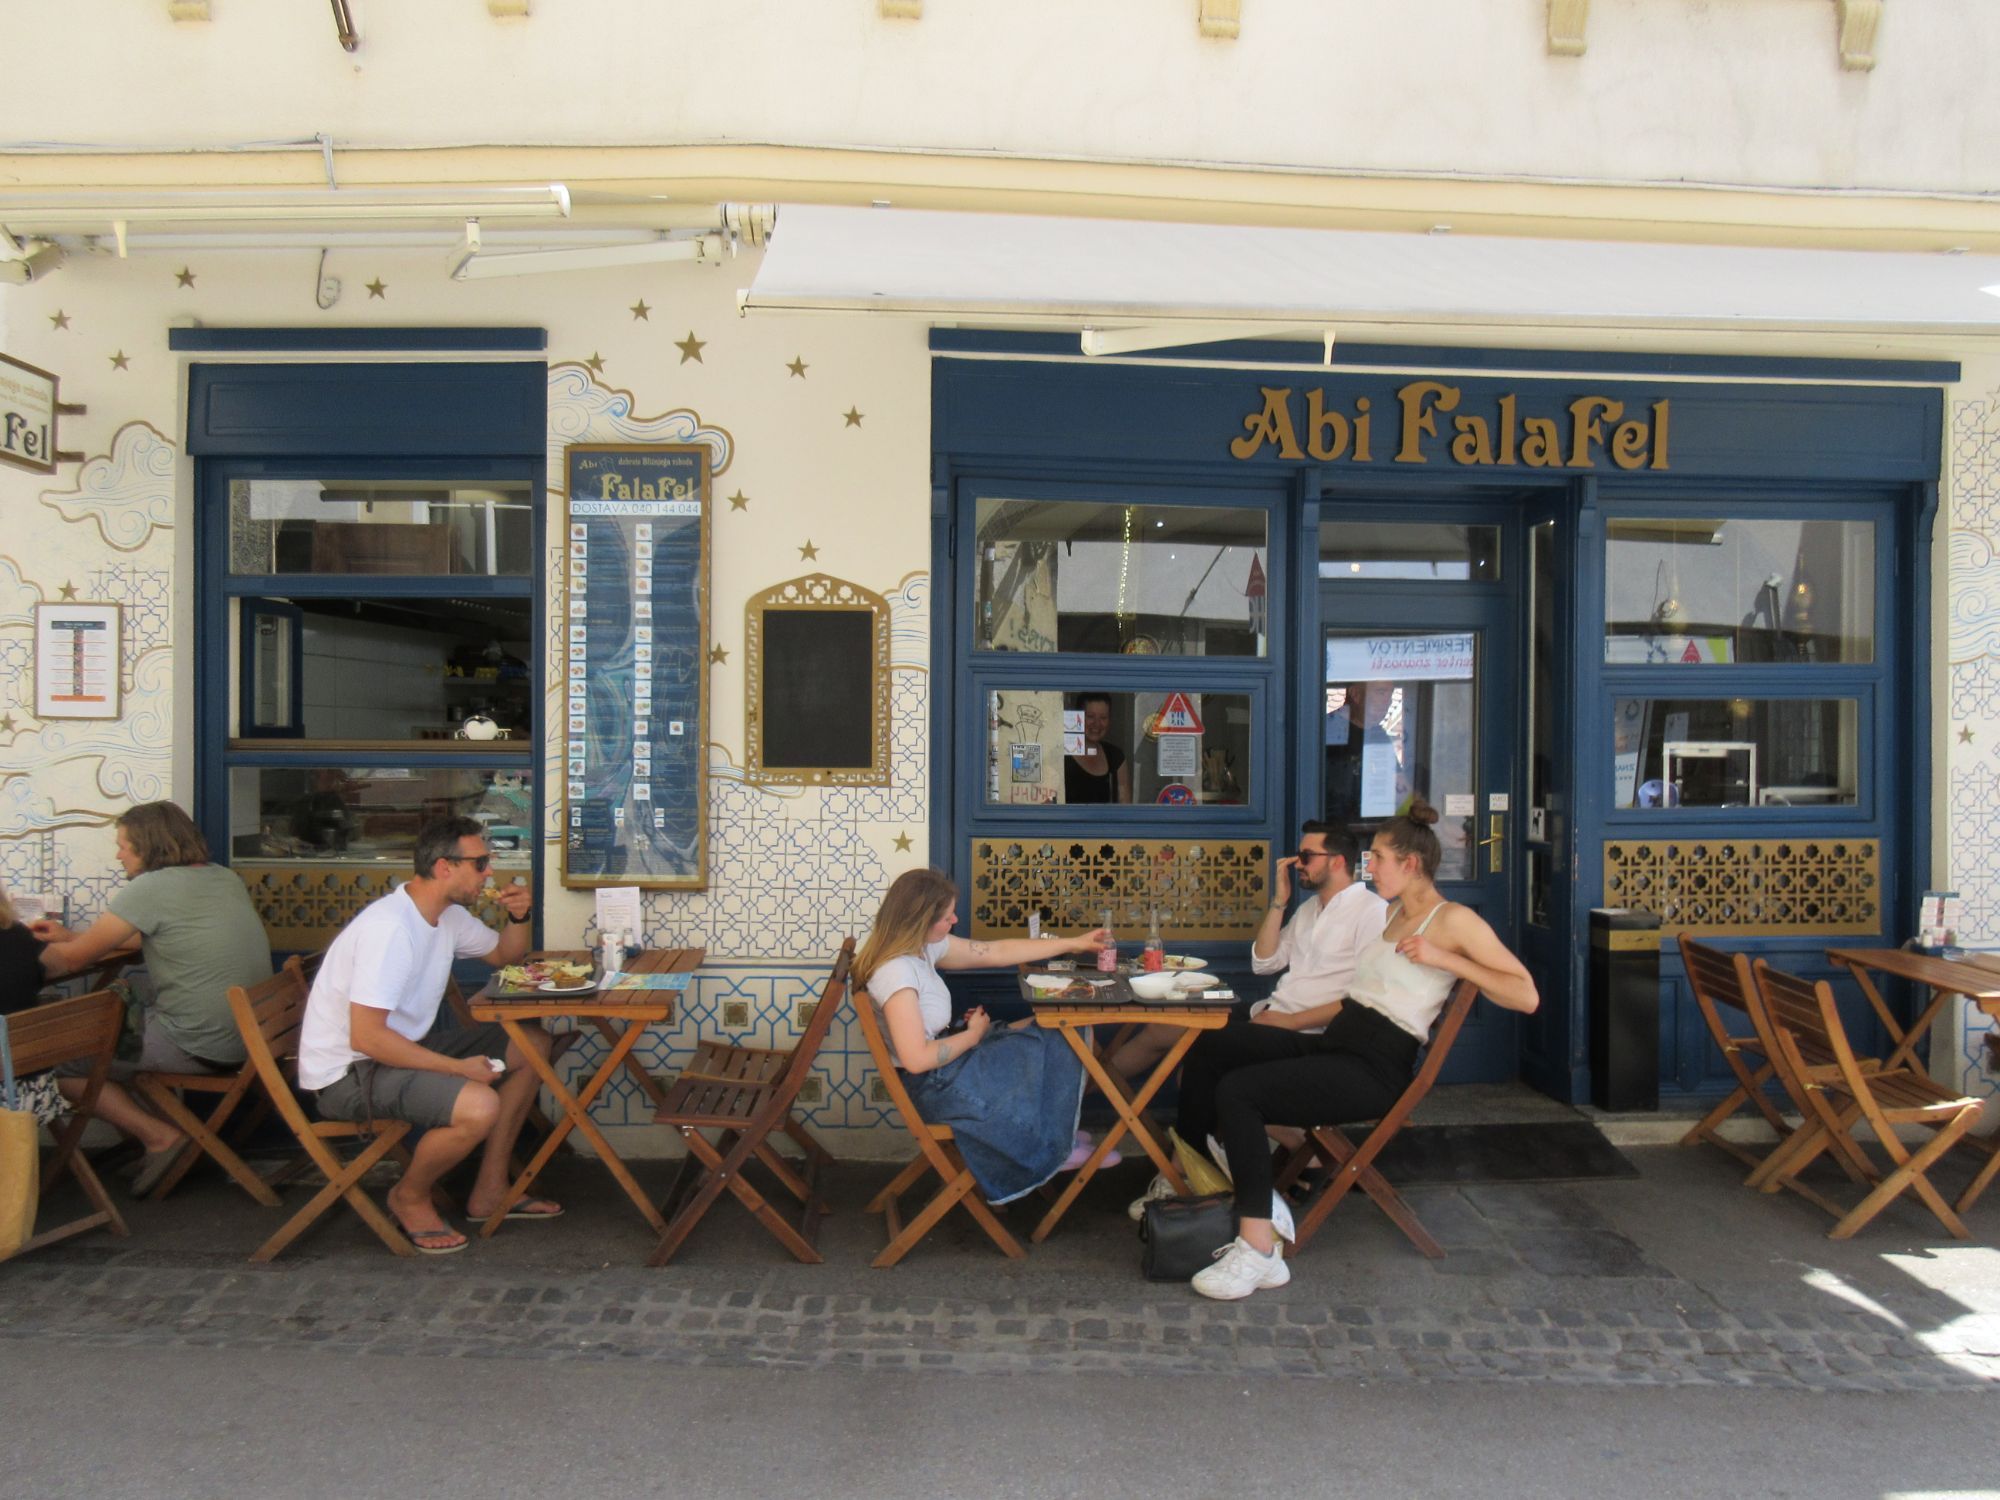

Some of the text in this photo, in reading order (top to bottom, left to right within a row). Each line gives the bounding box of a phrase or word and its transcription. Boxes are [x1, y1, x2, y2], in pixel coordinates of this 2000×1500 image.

[1230, 386, 1373, 462] Abi
[573, 503, 699, 514] DOSTAVA 040 144 044
